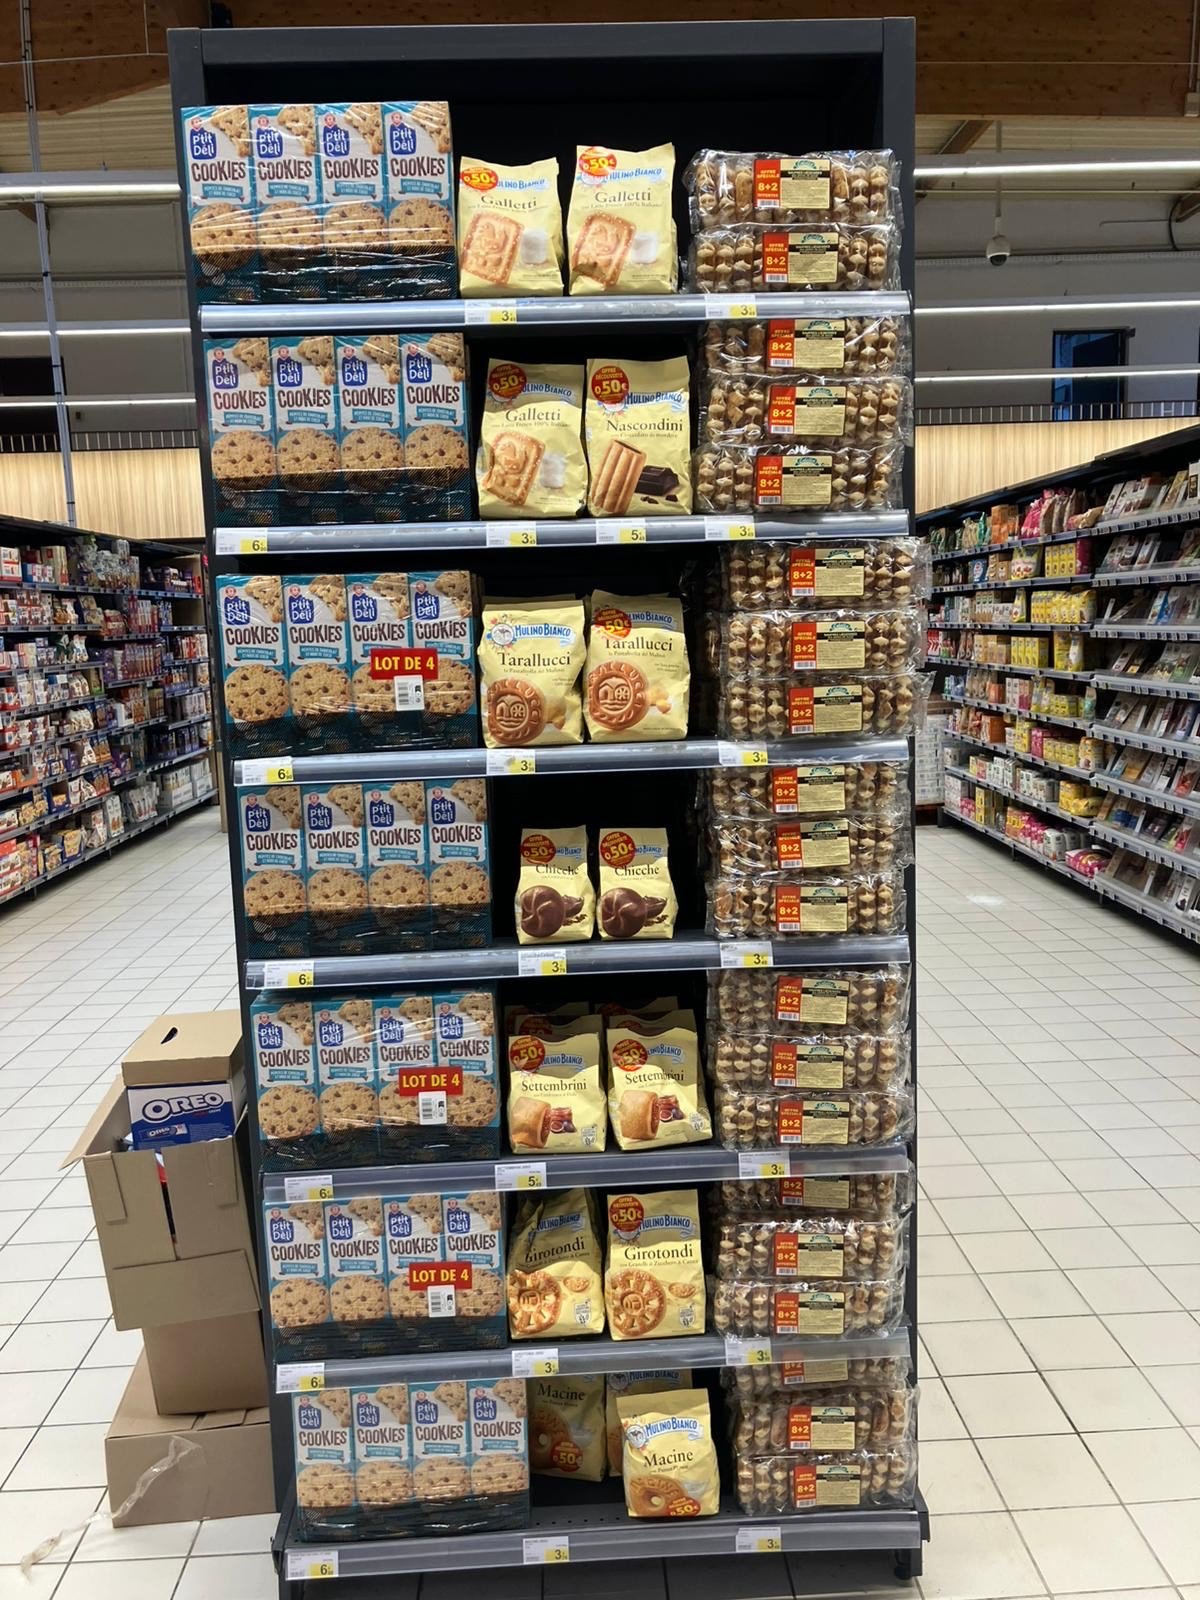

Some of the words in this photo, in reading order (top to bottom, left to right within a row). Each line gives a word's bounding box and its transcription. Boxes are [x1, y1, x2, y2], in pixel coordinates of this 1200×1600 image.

[191, 161, 246, 182] COOKIES
[258, 159, 312, 180] COOKIES
[324, 158, 378, 179] COOKIES
[391, 156, 445, 177] COOKIES
[758, 183, 778, 191] 8+2
[481, 195, 537, 209] Galletti
[595, 188, 651, 203] Galletti
[766, 257, 786, 265] 8+2
[772, 342, 791, 350] 8+2
[277, 388, 331, 408] COOKIES
[342, 387, 395, 407] COOKIES
[406, 384, 460, 404] COOKIES
[545, 384, 572, 396] BIANCO
[628, 392, 654, 404] MULINO
[213, 390, 266, 409] COOKIES
[506, 408, 560, 422] Galletti
[772, 409, 792, 417] 8+2
[607, 418, 683, 431] Nascondini
[760, 479, 780, 487] 8+2
[793, 571, 812, 580] 8+2
[646, 611, 672, 623] BIANCO
[225, 626, 279, 645] COOKIES
[289, 624, 342, 644] COOKIES
[353, 622, 405, 642] COOKIES
[415, 620, 467, 640] COOKIES
[515, 625, 542, 636] MULINO
[544, 623, 571, 636] BIANCO
[795, 644, 814, 653] 8+2
[374, 658, 400, 670] LOT
[404, 658, 422, 670] DE
[426, 657, 435, 670] 4
[497, 651, 570, 667] Tarallucci
[793, 709, 812, 717] 8+2
[776, 788, 795, 796] 8+2
[246, 832, 298, 851] COOKIES
[308, 831, 360, 849] COOKIES
[370, 828, 421, 846] COOKIES
[431, 825, 482, 843] COOKIES
[781, 844, 799, 852] 8+2
[615, 864, 659, 876] Chicche
[779, 907, 798, 915] 8+2
[780, 996, 798, 1005] 8+2
[320, 1046, 370, 1065] COOKIES
[380, 1044, 430, 1062] COOKIES
[440, 1039, 489, 1057] COOKIES
[661, 1044, 681, 1056] BIANCO
[259, 1049, 310, 1068] COOKIES
[402, 1076, 426, 1088] LOT
[431, 1074, 447, 1087] DE
[451, 1074, 460, 1086] 4
[625, 1069, 684, 1084] Settembrini
[521, 1079, 586, 1091] Settembrini
[143, 1093, 223, 1121] OREO
[782, 1119, 800, 1127] 8+2
[665, 1215, 690, 1228] BIANCO
[330, 1240, 379, 1258] COOKIES
[389, 1237, 438, 1255] COOKIES
[447, 1234, 496, 1251] COOKIES
[271, 1243, 320, 1261] COOKIES
[624, 1244, 693, 1260] Girotondi
[777, 1253, 796, 1261] 8+2
[412, 1270, 436, 1283] LOT
[441, 1269, 456, 1282] DE
[460, 1269, 469, 1281] 4
[778, 1311, 796, 1319] 8+2
[538, 1384, 586, 1400] Macine
[415, 1425, 463, 1441] COOKIES
[474, 1420, 522, 1437] COOKIES
[646, 1420, 671, 1437] MULINO
[672, 1417, 697, 1430] BIANCO
[792, 1426, 809, 1434] 8+2
[299, 1430, 347, 1446] COOKIES
[357, 1428, 405, 1444] COOKIES
[644, 1449, 694, 1467] Macine
[798, 1485, 814, 1493] 8+2
